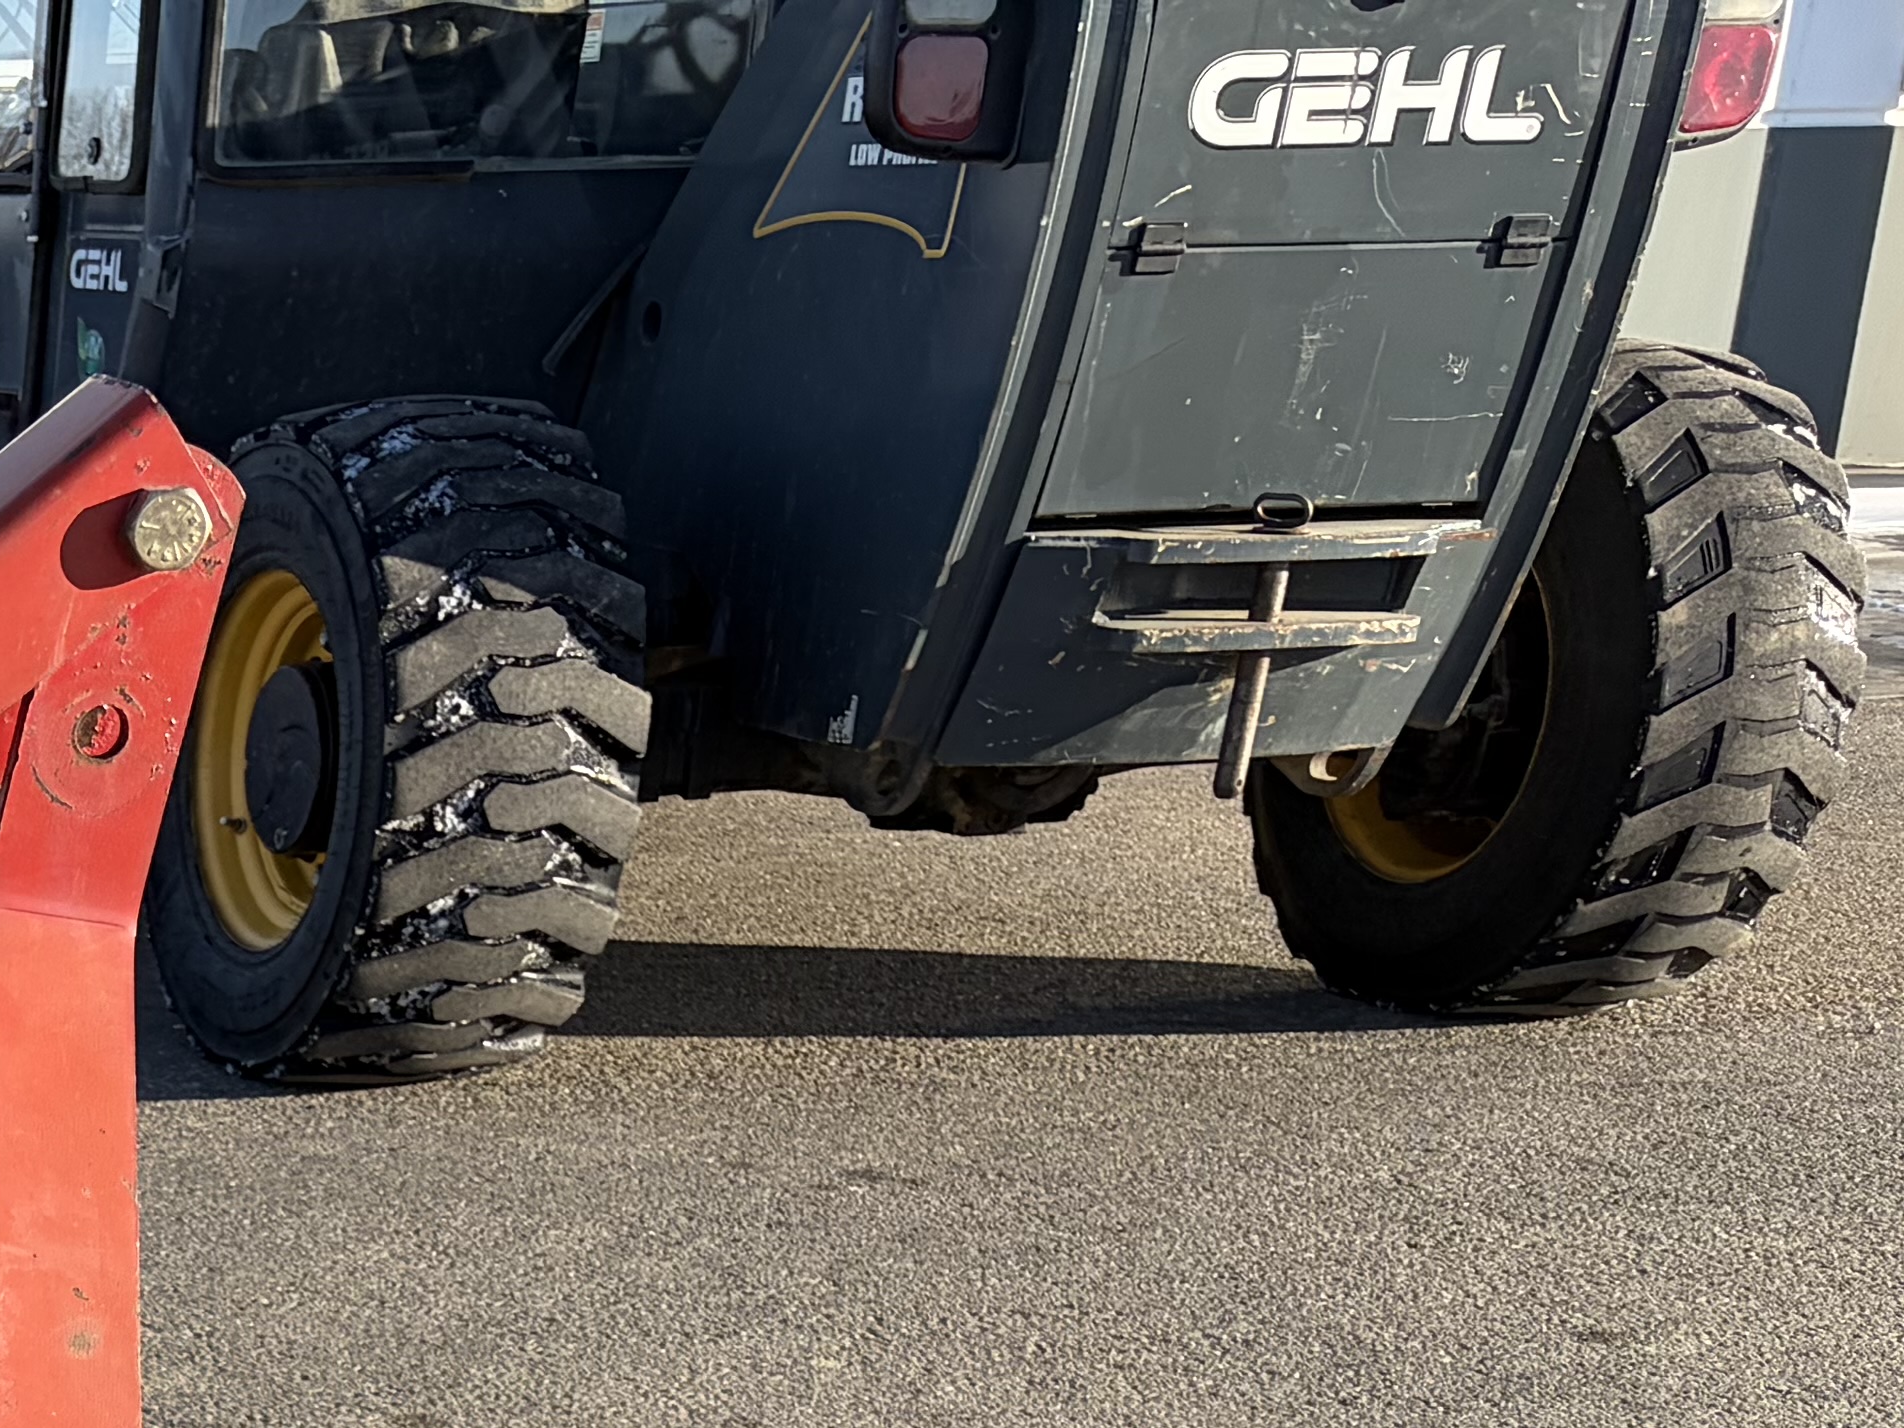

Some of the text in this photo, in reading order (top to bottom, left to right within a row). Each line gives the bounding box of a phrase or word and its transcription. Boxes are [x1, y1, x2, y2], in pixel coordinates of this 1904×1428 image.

[1188, 45, 1543, 150] GEHL
[849, 143, 882, 166] LOW
[70, 248, 128, 292] GEHL
